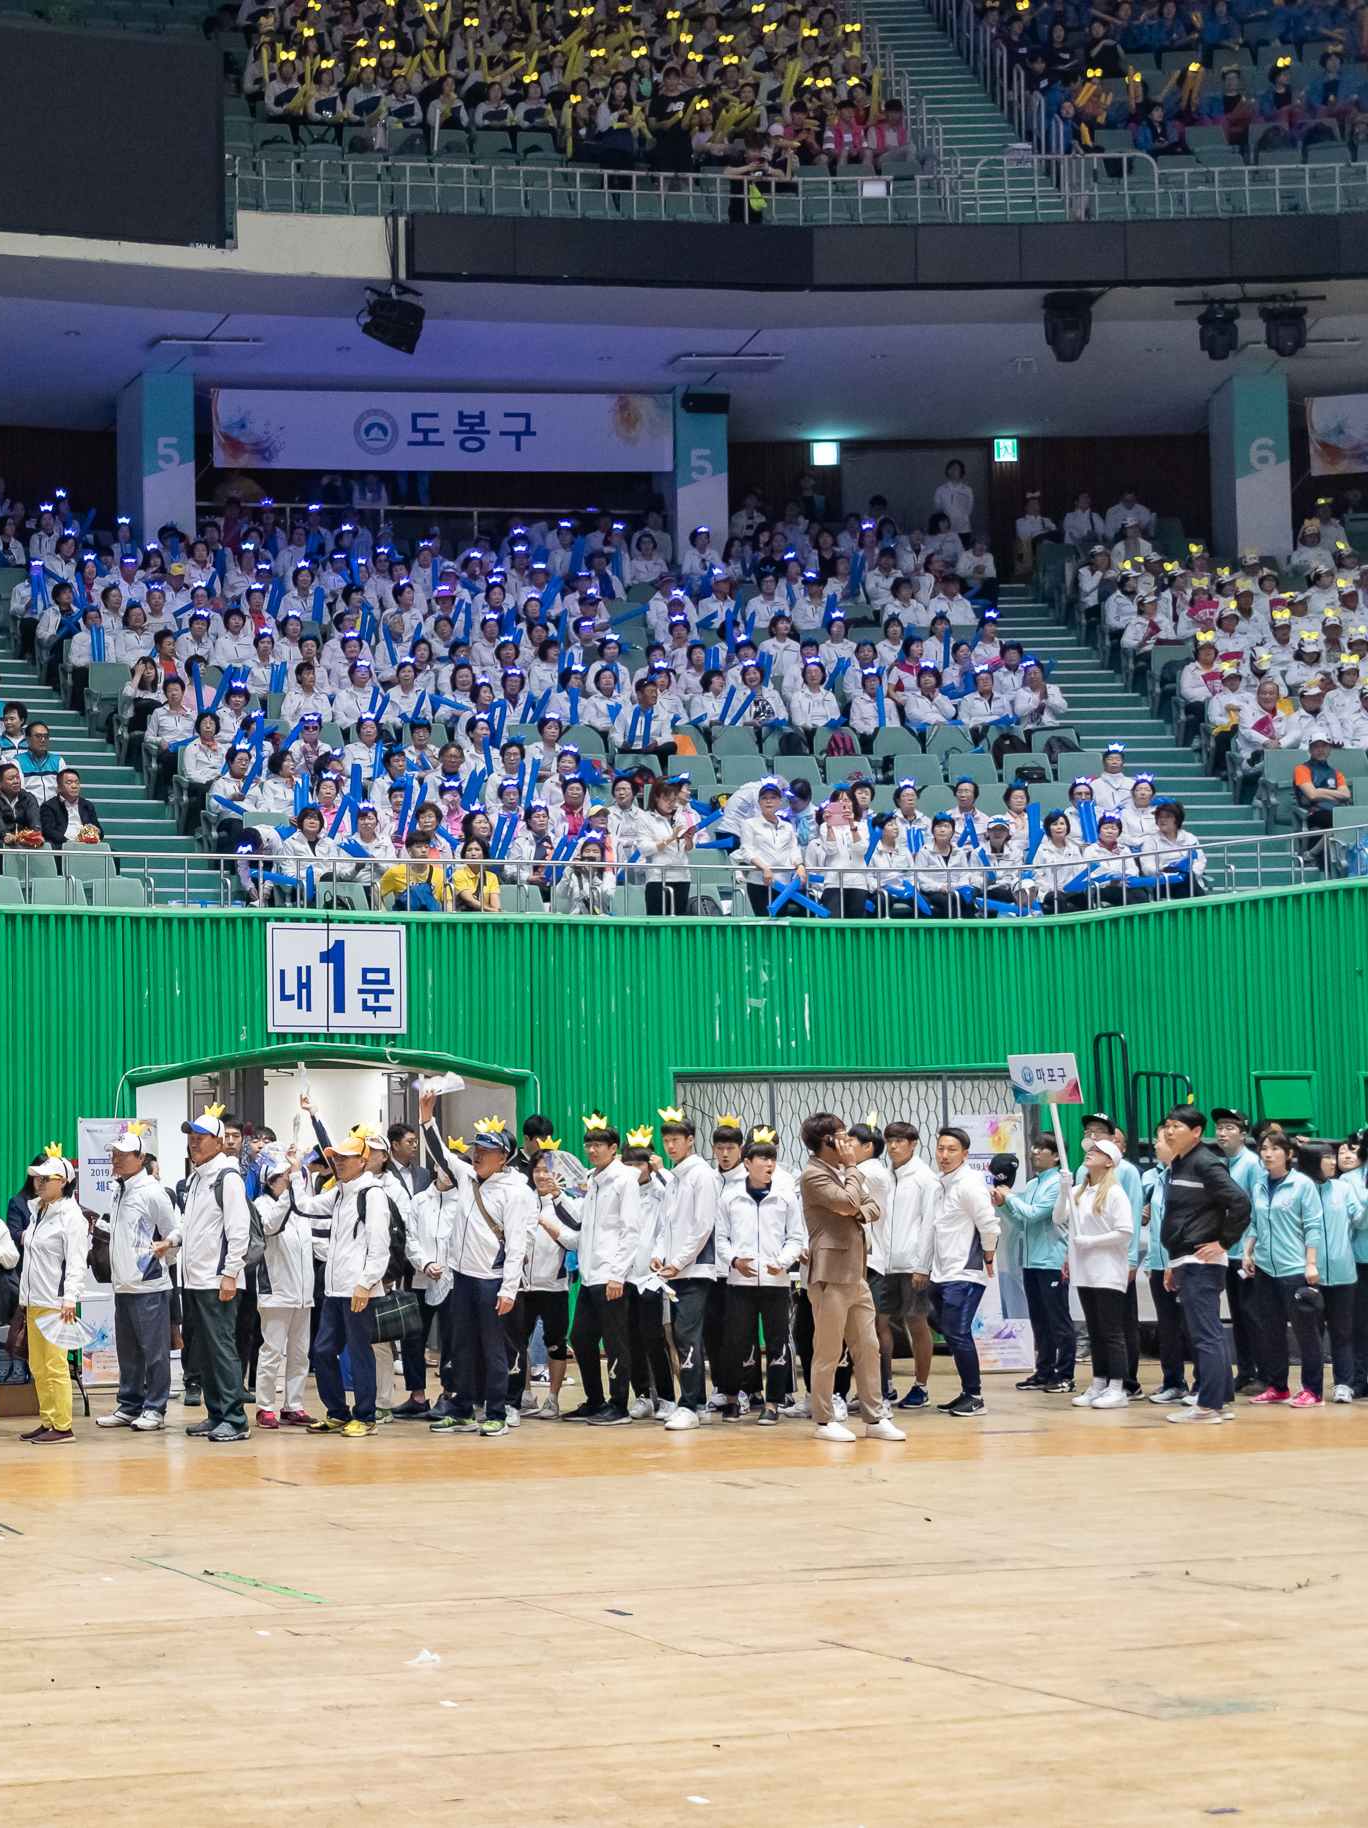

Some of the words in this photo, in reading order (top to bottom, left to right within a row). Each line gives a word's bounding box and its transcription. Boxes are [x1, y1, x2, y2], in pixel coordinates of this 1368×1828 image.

[407, 410, 537, 453] 도봉구
[157, 436, 180, 470] 5
[690, 448, 713, 481] 5
[1249, 437, 1277, 472] 6
[1035, 1067, 1067, 1085] 마포구
[90, 1168, 110, 1177] 2019
